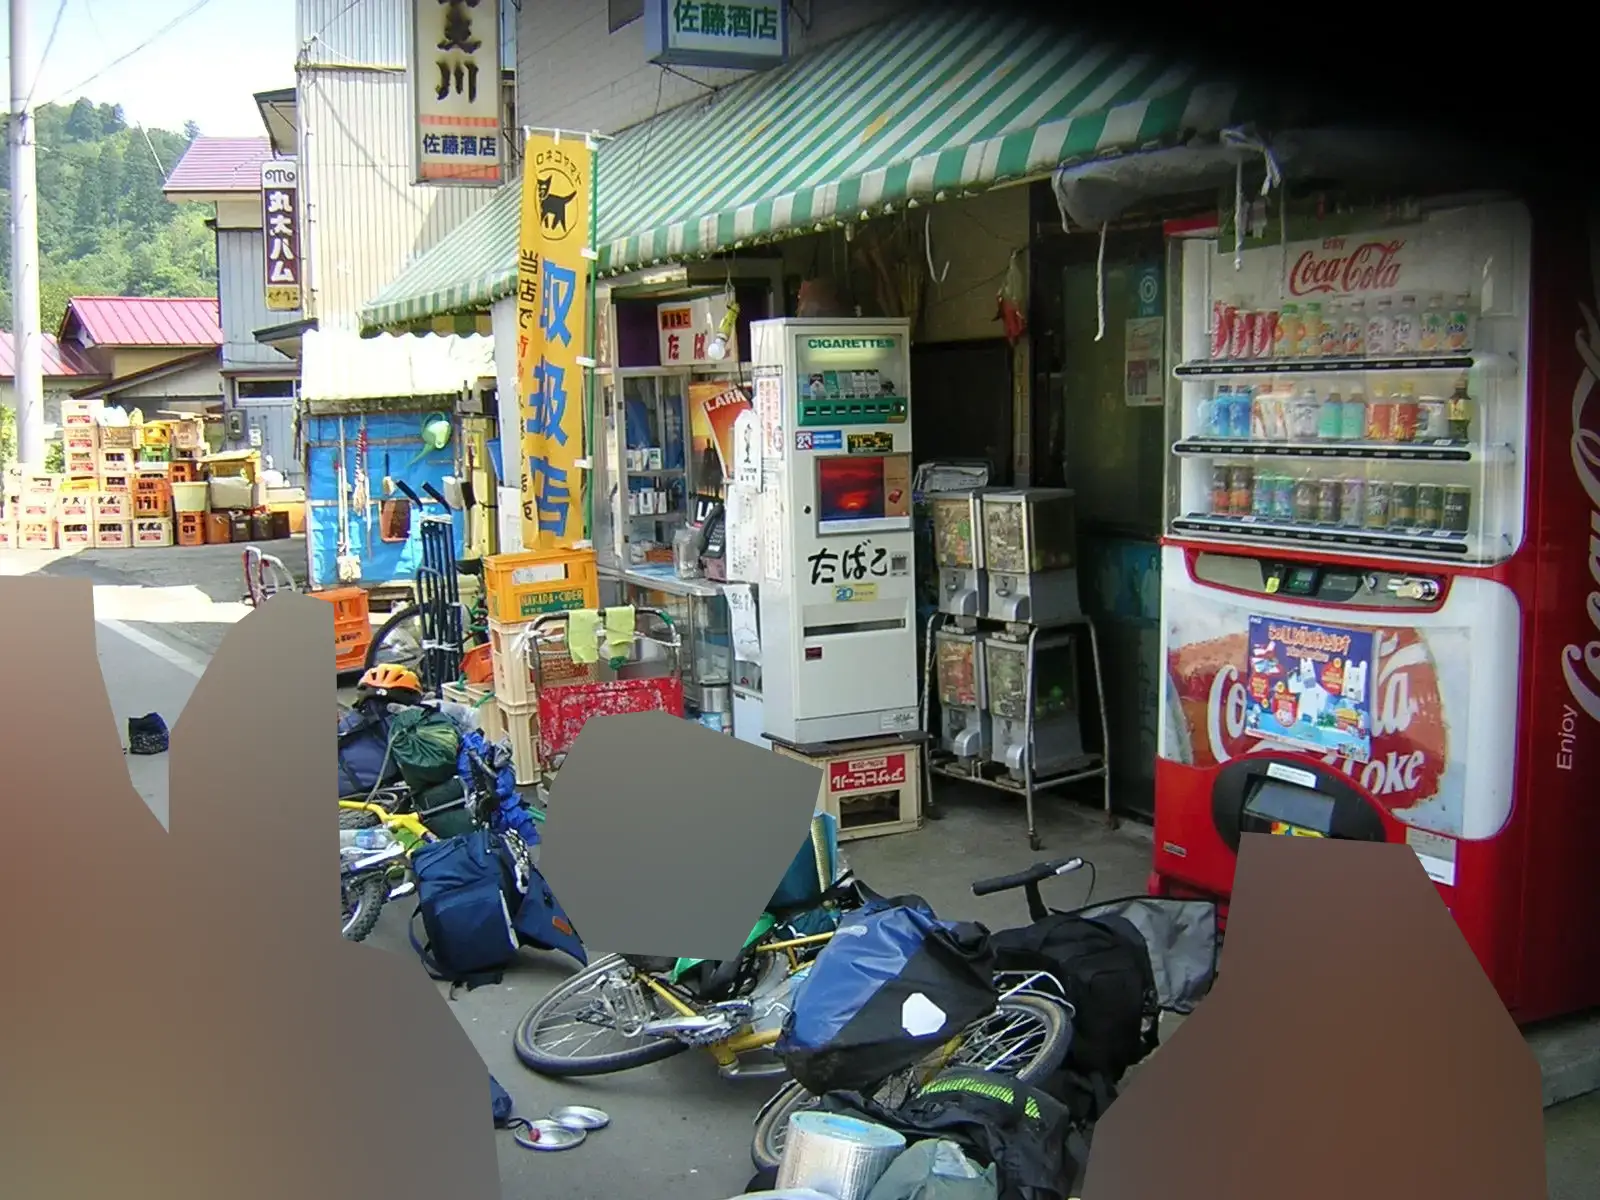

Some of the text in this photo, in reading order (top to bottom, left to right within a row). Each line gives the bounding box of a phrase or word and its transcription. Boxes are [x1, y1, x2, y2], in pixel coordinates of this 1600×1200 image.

[674, 1, 778, 40] 佐藤酒店
[422, 133, 497, 157] 佐藤酒店
[268, 191, 295, 282] 丸大ハム
[808, 338, 896, 349] CIGARETTES
[527, 258, 576, 537] 取扱店
[808, 539, 888, 585] たばこ
[1556, 704, 1578, 770] Enjoy
